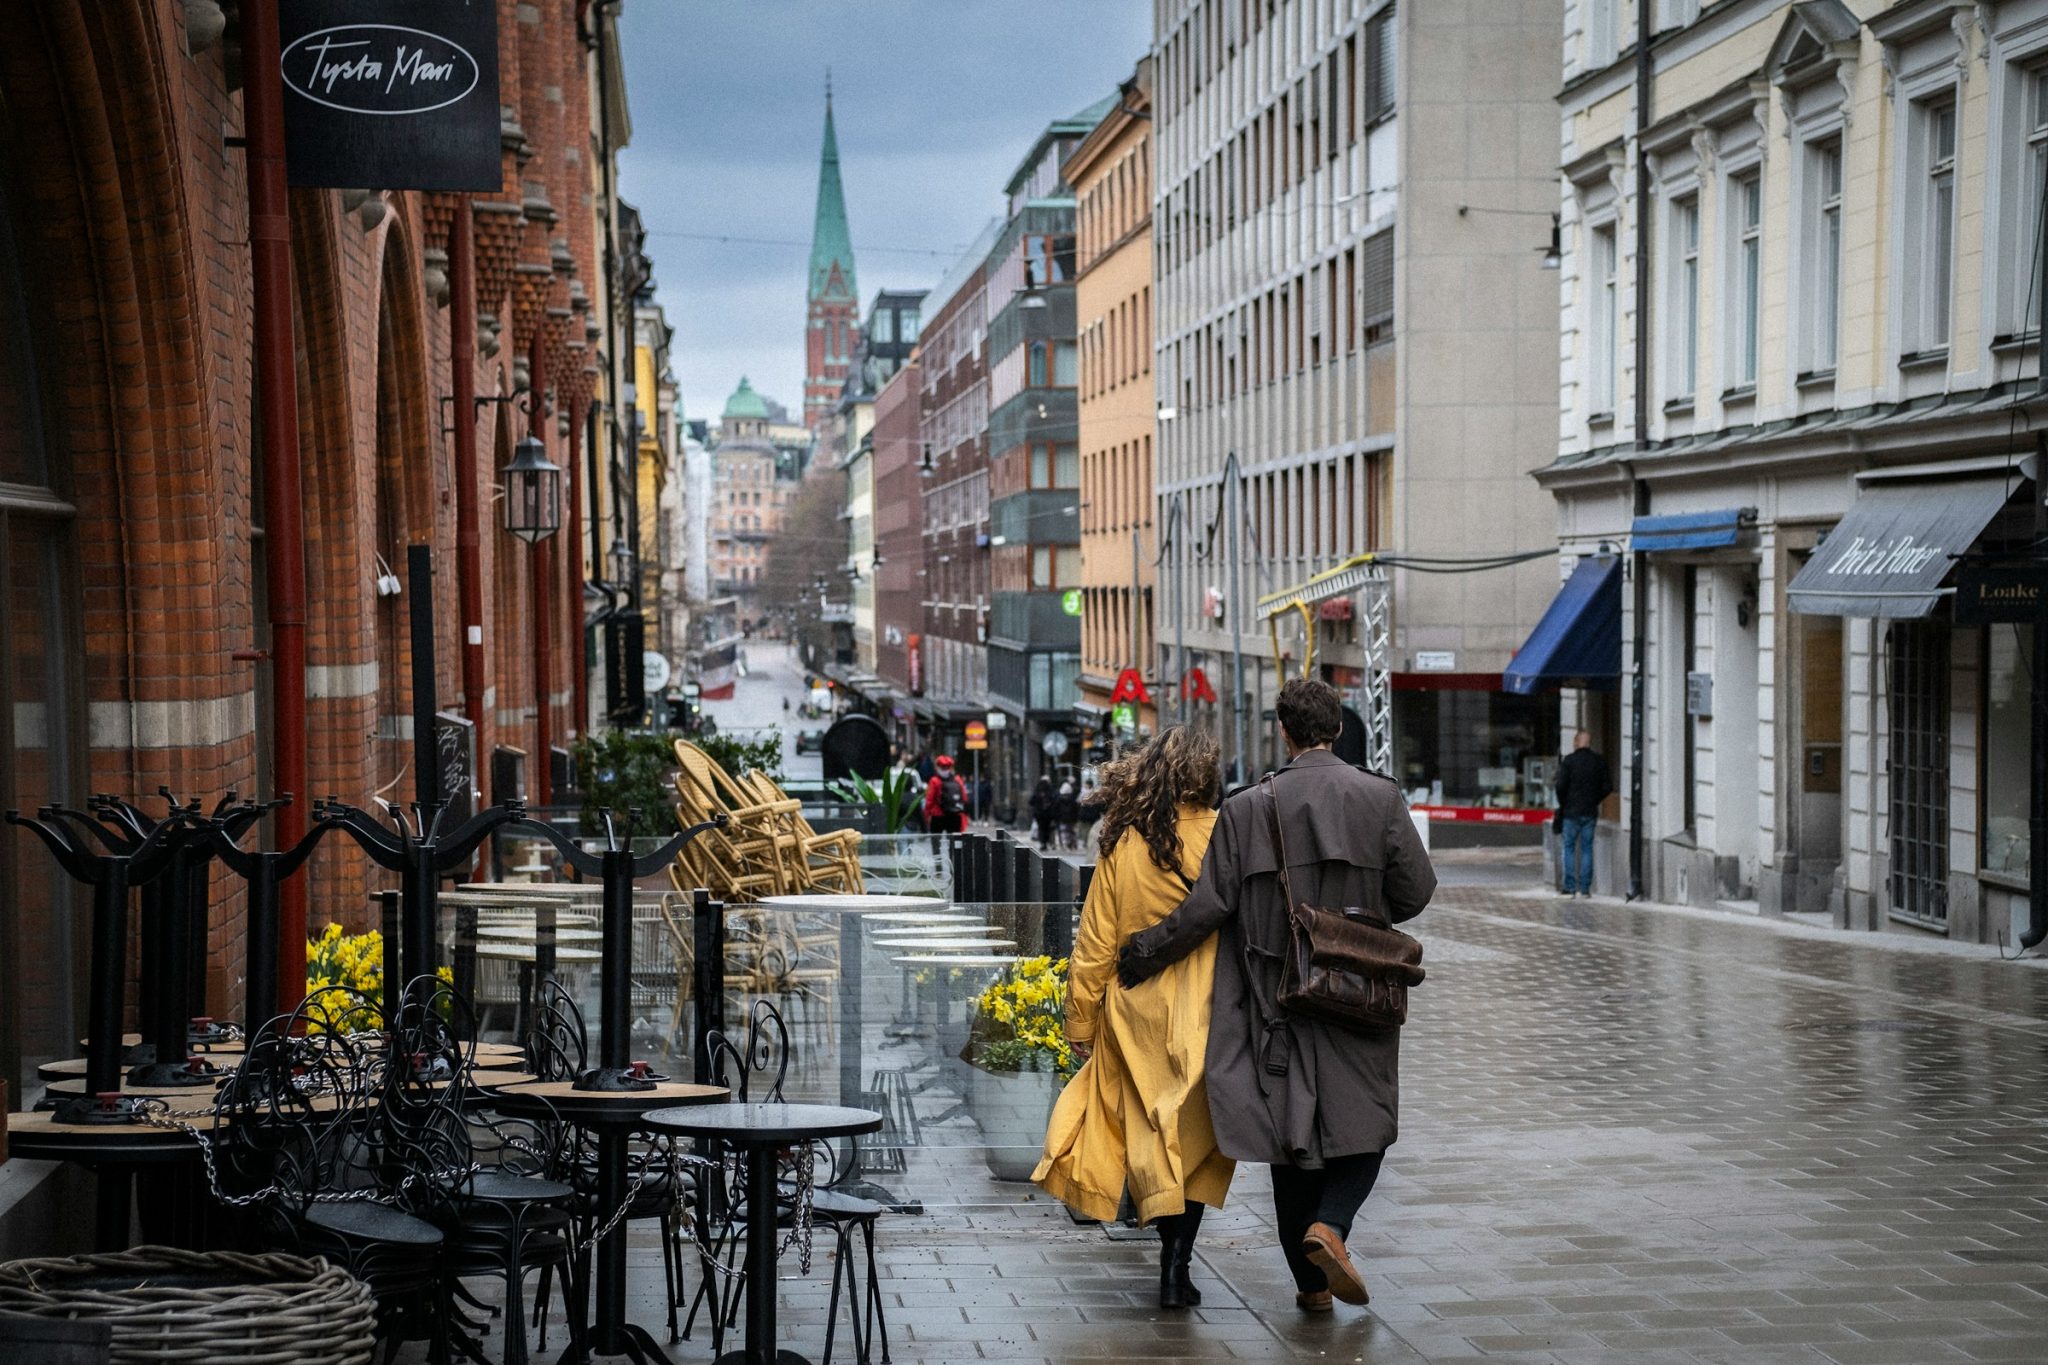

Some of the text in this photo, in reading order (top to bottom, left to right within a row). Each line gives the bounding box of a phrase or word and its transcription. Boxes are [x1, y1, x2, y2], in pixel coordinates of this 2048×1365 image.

[304, 36, 457, 94] Tysta Mari
[1875, 536, 1942, 575] Porter
[1980, 584, 2039, 598] Loake
